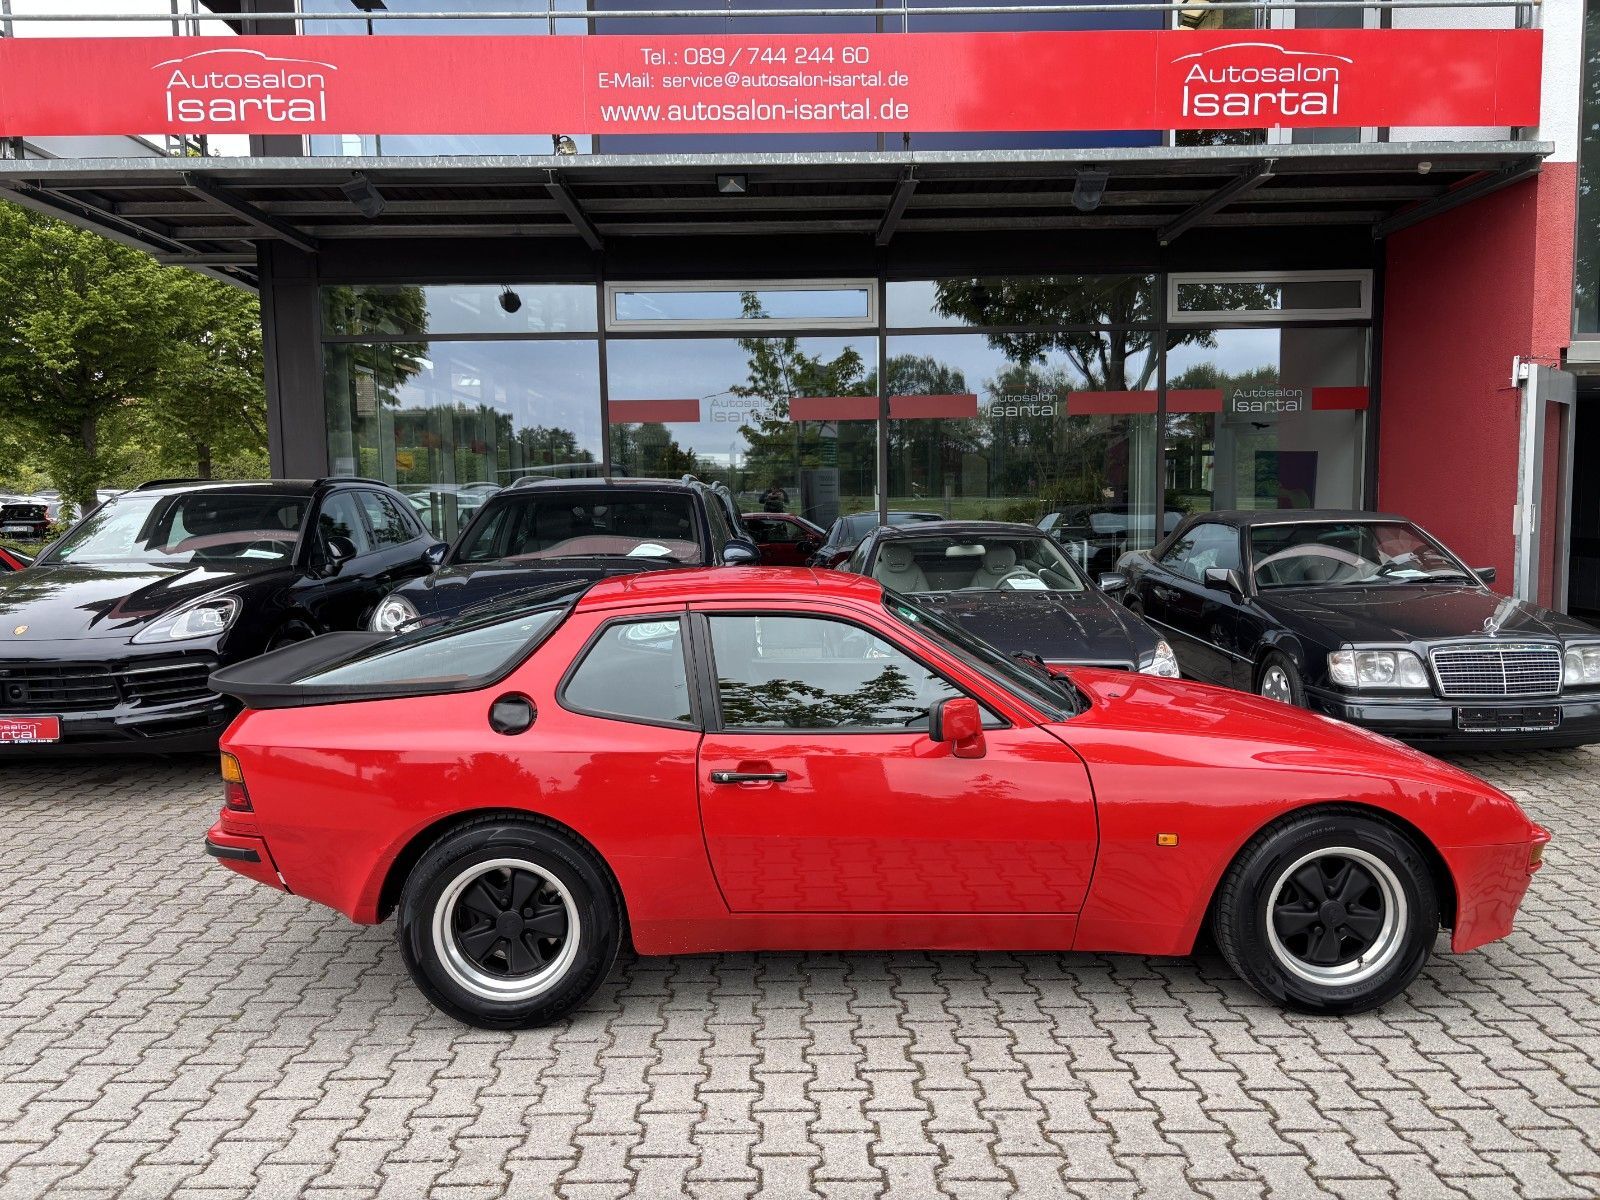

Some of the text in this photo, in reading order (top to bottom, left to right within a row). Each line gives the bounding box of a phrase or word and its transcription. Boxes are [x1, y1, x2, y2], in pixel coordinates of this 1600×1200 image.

[640, 48, 678, 65] Tel.:
[684, 47, 725, 65] 089
[747, 47, 787, 64] 744
[794, 46, 835, 64] 244
[842, 46, 869, 64] 60
[166, 68, 325, 89] Autosalon
[598, 70, 909, 88] E-Mail: service@autosalon-isartal.de
[1184, 62, 1339, 83] Autosalon
[166, 90, 327, 122] Isartal
[600, 97, 909, 121] www.autosalon-isartal.de
[1182, 84, 1339, 117] Isartal
[1233, 388, 1303, 398] Autosalon
[710, 399, 780, 408] Autosalo
[985, 401, 1058, 418] Isartal
[1232, 397, 1303, 412] Isartal
